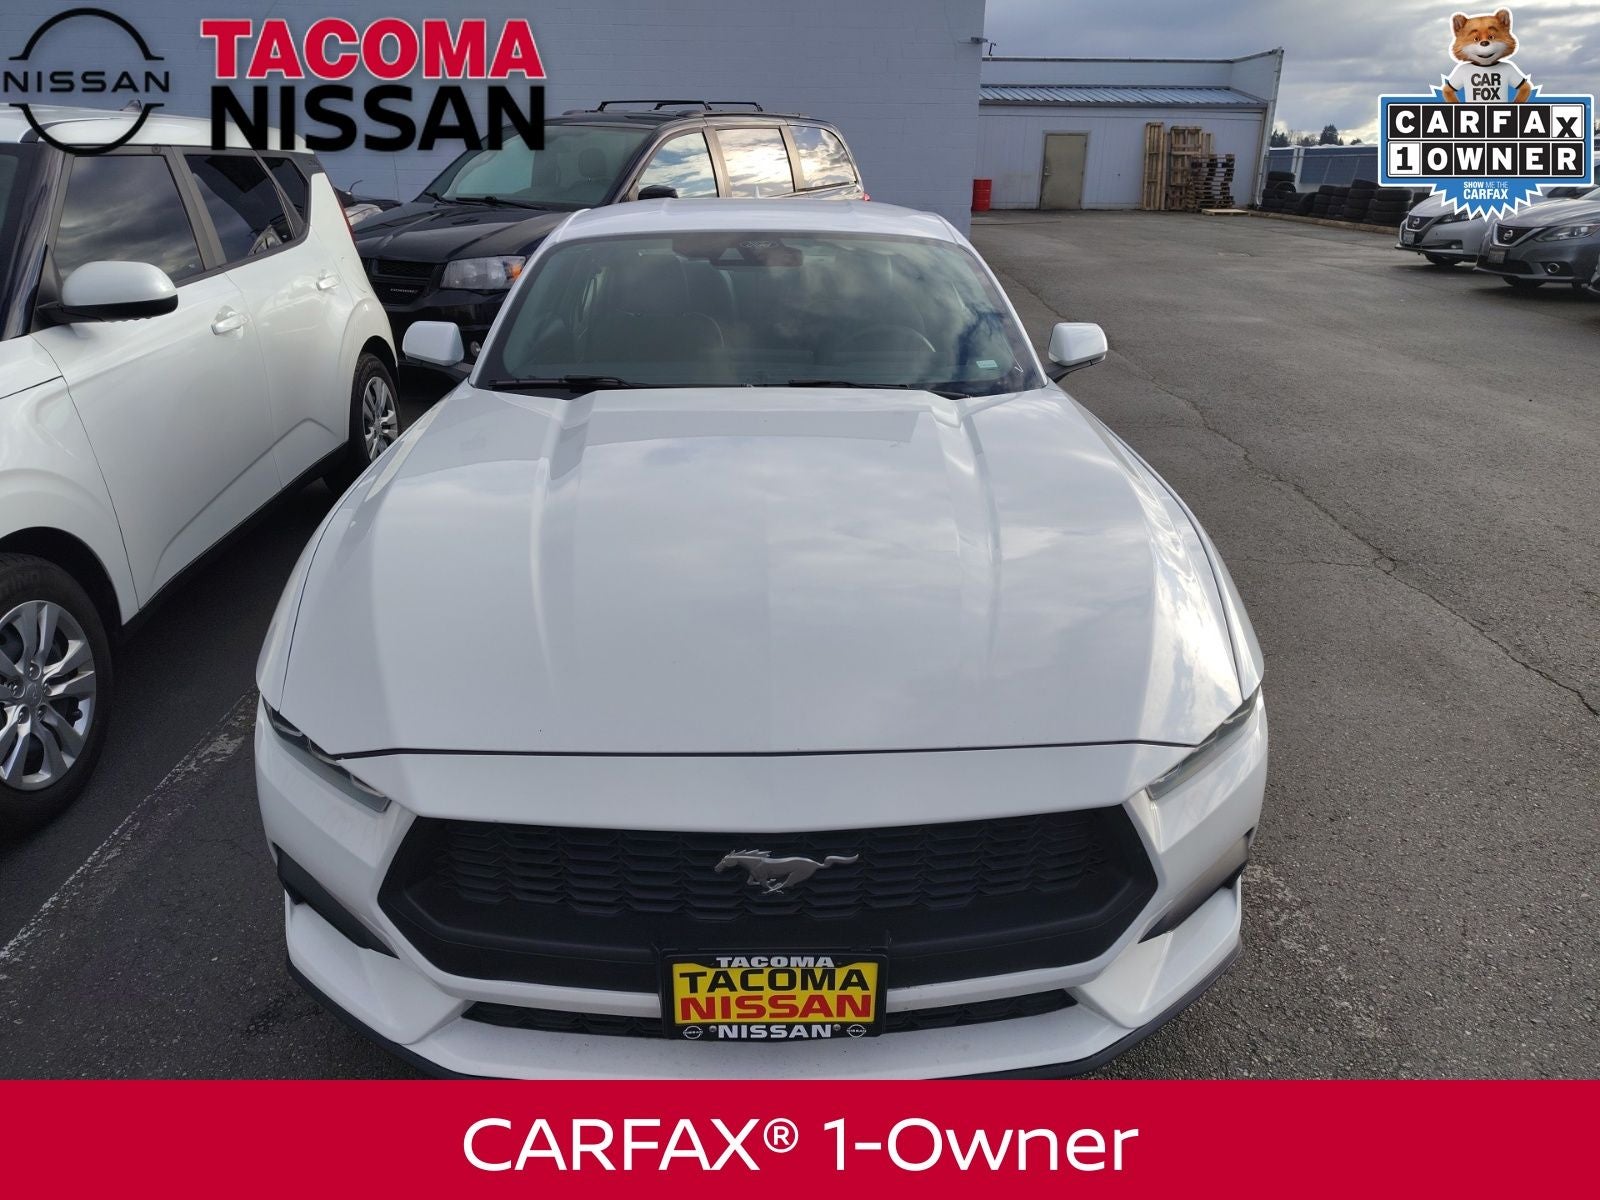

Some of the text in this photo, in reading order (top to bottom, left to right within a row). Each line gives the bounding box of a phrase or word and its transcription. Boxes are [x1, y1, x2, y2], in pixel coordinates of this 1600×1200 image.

[716, 956, 835, 968] TACOMA
[679, 968, 870, 994] TACOMA
[680, 994, 872, 1021] NISSAN
[718, 1024, 832, 1039] NISSAN
